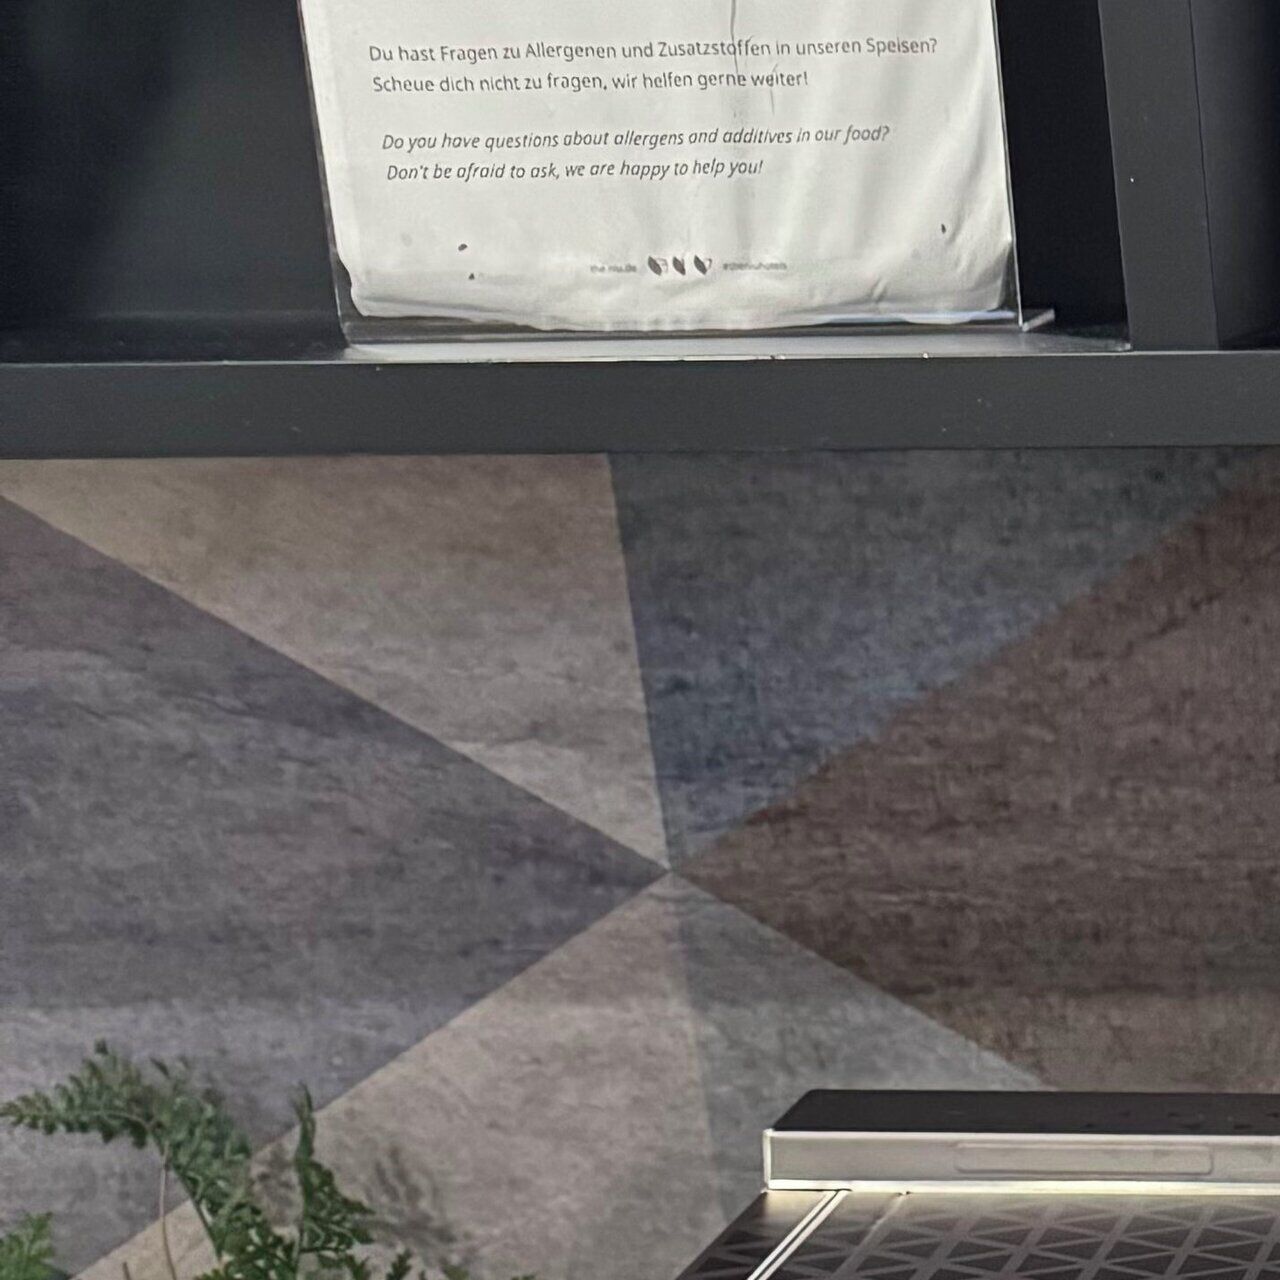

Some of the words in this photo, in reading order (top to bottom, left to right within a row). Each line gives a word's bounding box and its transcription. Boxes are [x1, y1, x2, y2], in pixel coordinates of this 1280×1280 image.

[369, 46, 393, 61] Du
[398, 46, 435, 61] hast
[440, 46, 498, 65] Fragen
[503, 47, 521, 59] zu
[526, 42, 616, 62] Allergenen
[622, 42, 653, 58] und
[658, 39, 771, 57] Zusatzstoffen
[776, 41, 790, 55] in
[796, 41, 861, 55] unseren
[866, 37, 937, 57] Speisen?
[373, 76, 434, 92] Scheue
[440, 76, 474, 92] dich
[480, 75, 520, 91] nicht
[524, 78, 542, 89] zu
[547, 72, 607, 92] fragen,
[612, 73, 637, 89] wir
[643, 72, 692, 89] helfen
[698, 72, 746, 90] gerne
[751, 68, 808, 87] weiter!
[382, 134, 404, 150] Do
[407, 137, 437, 154] you
[441, 132, 480, 148] have
[485, 133, 559, 152] questions
[564, 131, 609, 146] about
[614, 130, 684, 150] allergens
[689, 128, 719, 144] and
[723, 127, 793, 143] additives
[796, 128, 810, 143] in
[815, 129, 842, 141] our
[843, 124, 890, 145] food?
[387, 165, 429, 180] Don't
[433, 163, 452, 179] be
[457, 162, 505, 182] afraid
[511, 165, 525, 179] to
[531, 162, 559, 180] ask,
[565, 165, 585, 177] we
[590, 164, 615, 176] are
[620, 160, 670, 180] happy
[674, 163, 688, 176] to
[693, 157, 725, 178] help
[728, 160, 763, 178] you!
